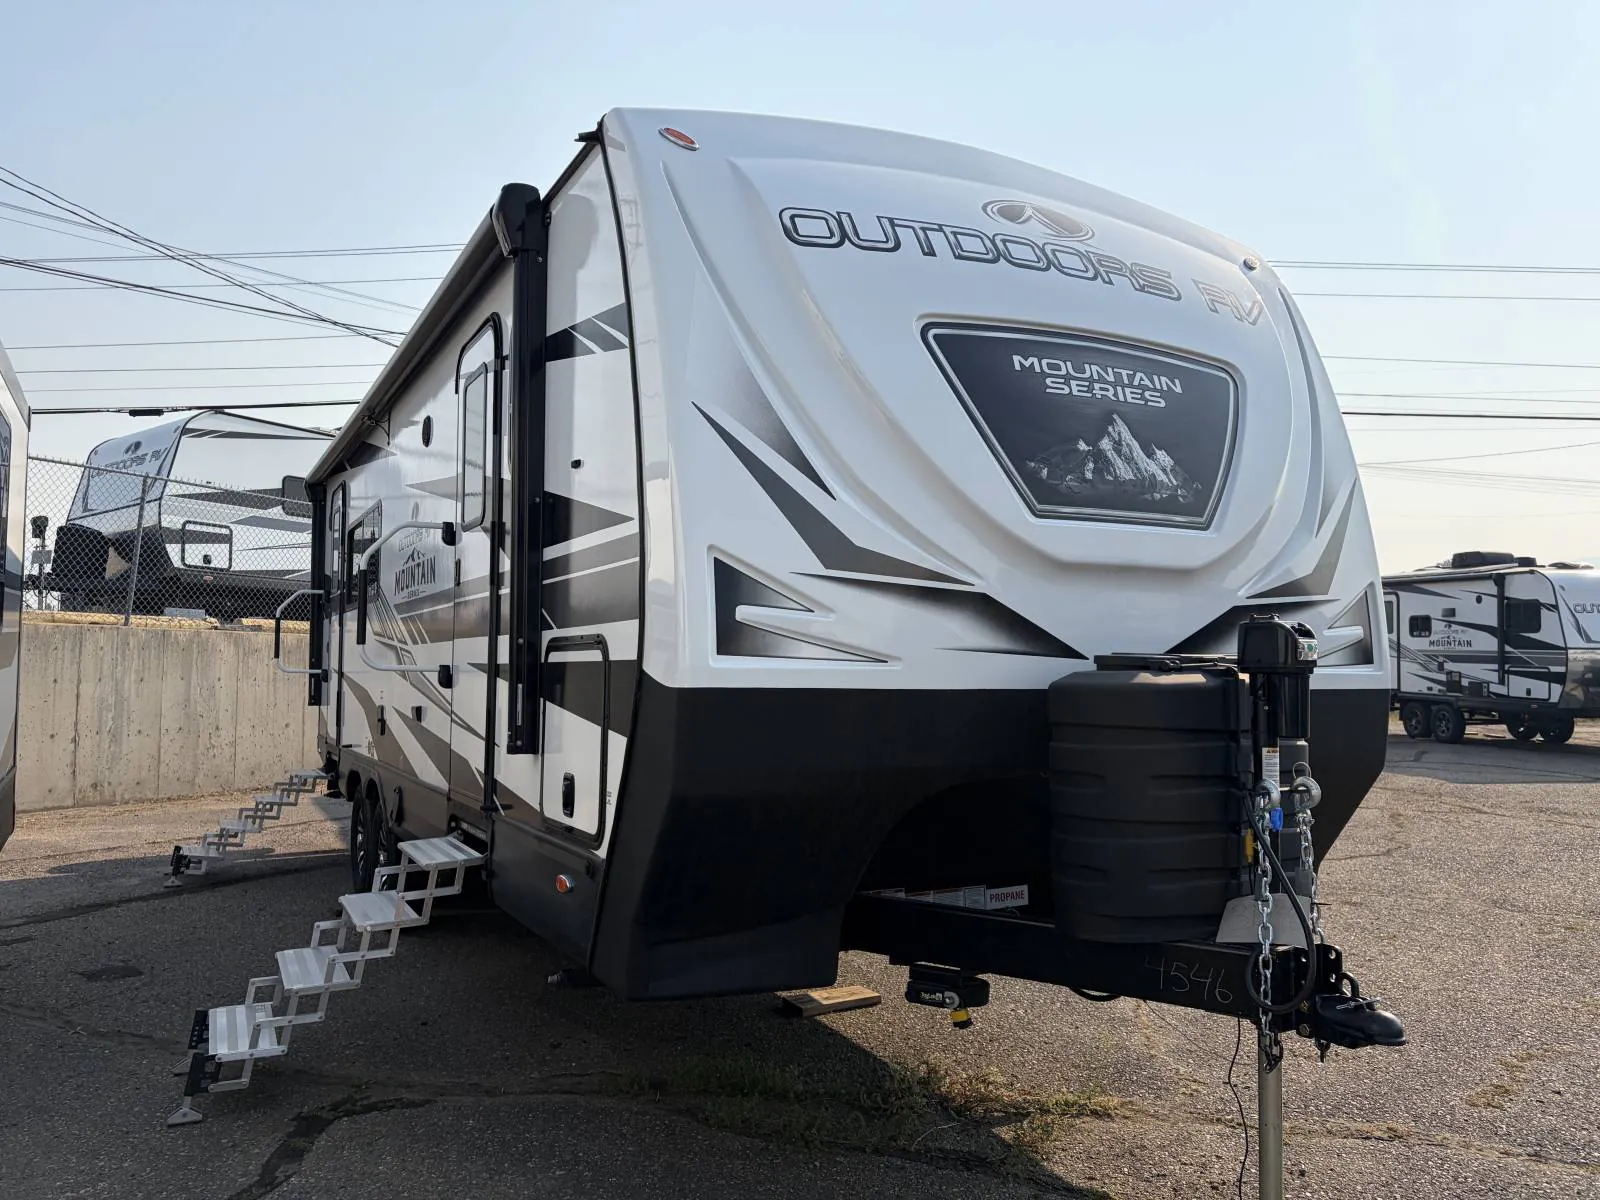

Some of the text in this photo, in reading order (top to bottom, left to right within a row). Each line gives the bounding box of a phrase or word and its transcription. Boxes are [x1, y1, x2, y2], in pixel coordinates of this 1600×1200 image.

[779, 207, 1264, 326] OUTDOORS RV
[1012, 354, 1183, 394] MOUNTAIN
[1045, 377, 1167, 408] SERIES
[394, 555, 436, 596] MOUNTAIN
[1429, 639, 1472, 648] MOUNTAIN
[989, 890, 1025, 903] PROPANE
[1145, 952, 1233, 1004] 4546
